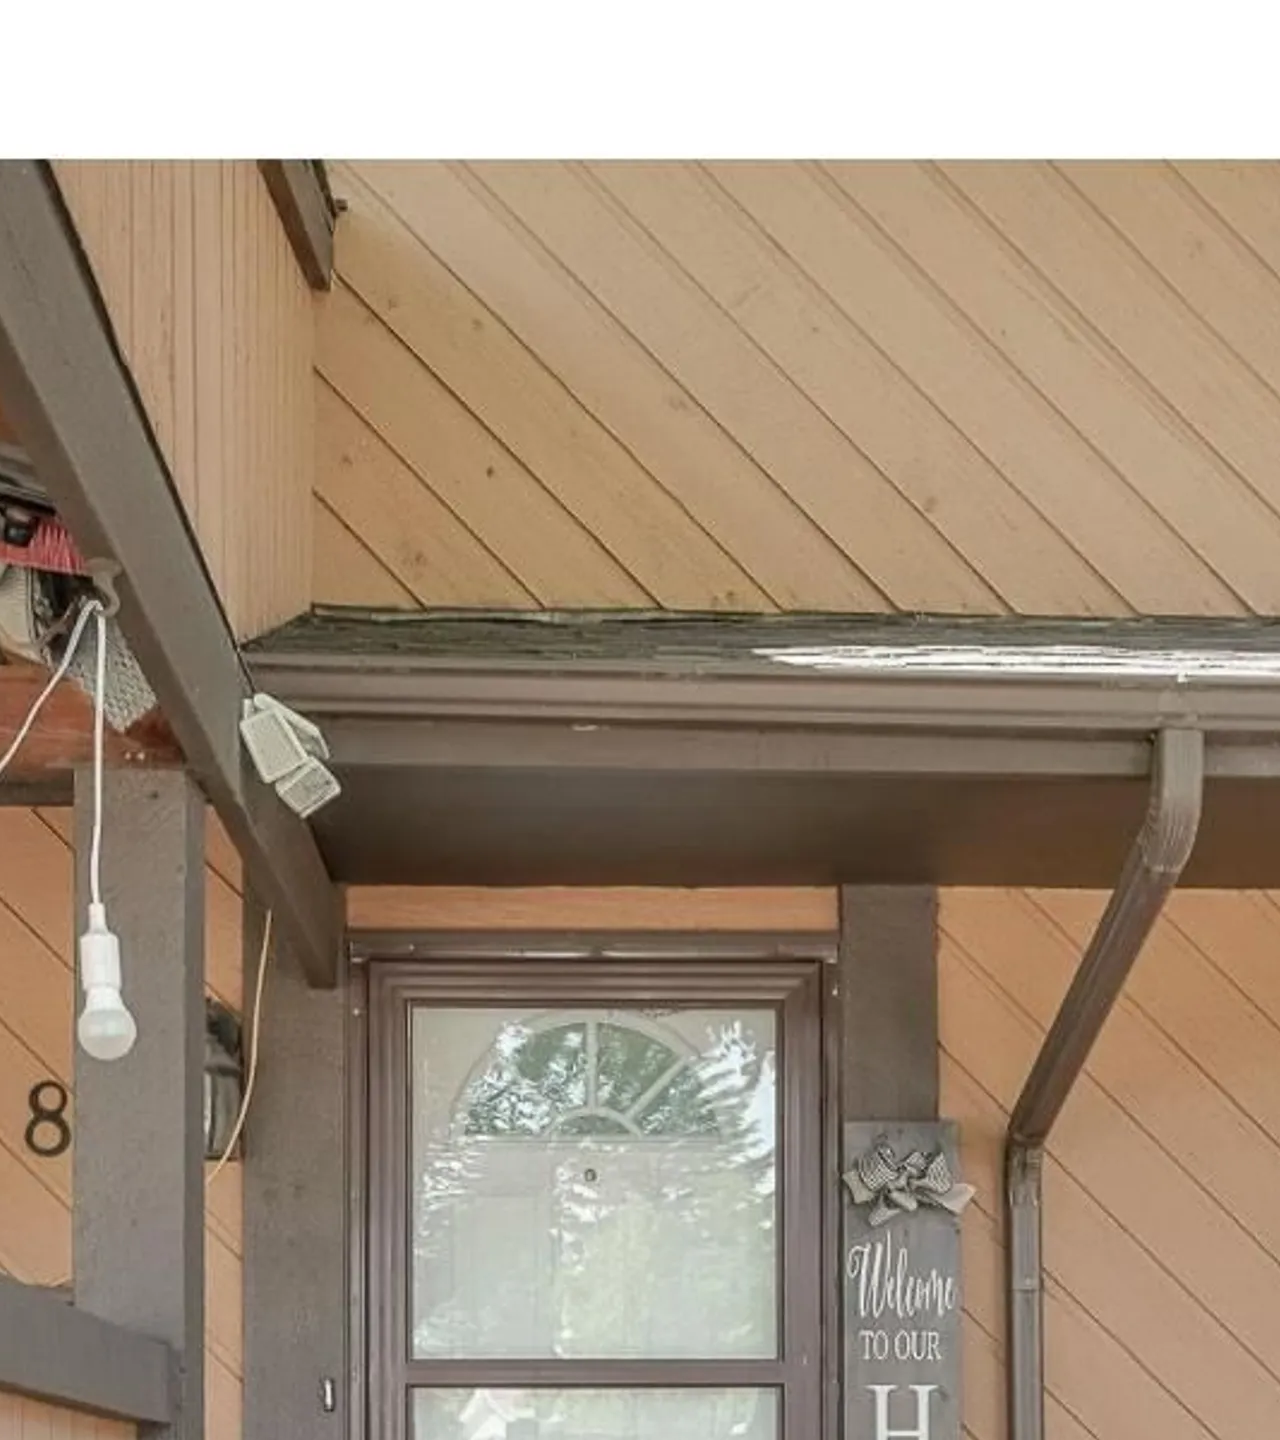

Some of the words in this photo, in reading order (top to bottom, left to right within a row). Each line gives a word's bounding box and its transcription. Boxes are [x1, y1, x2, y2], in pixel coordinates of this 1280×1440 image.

[25, 1080, 71, 1157] 8
[847, 1229, 956, 1318] Welcome
[859, 1329, 889, 1361] TO
[894, 1329, 942, 1361] OUR
